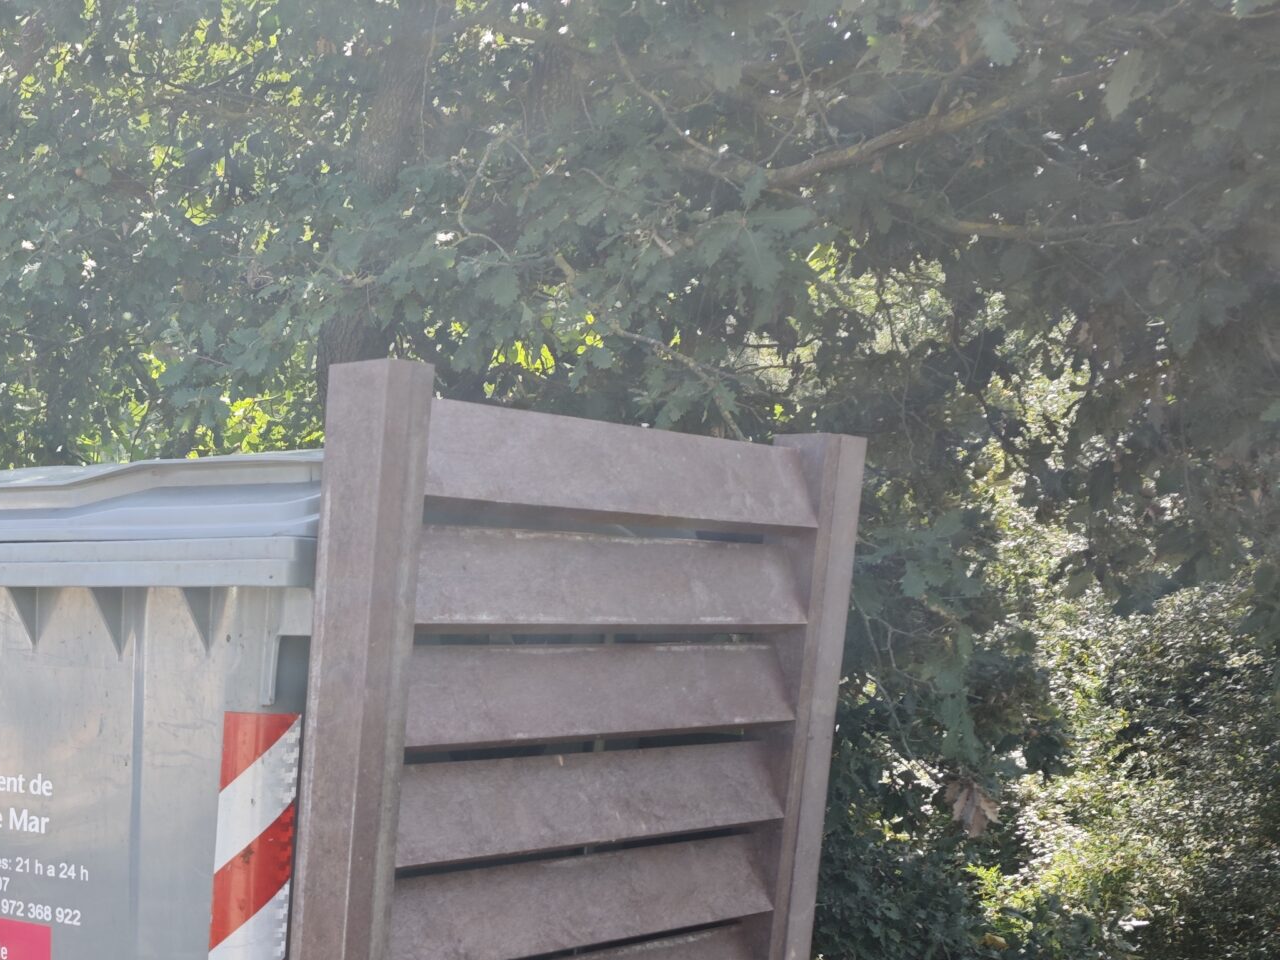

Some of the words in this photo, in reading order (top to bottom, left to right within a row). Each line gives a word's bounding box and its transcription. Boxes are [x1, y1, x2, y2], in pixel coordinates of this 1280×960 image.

[29, 773, 54, 797] de
[9, 807, 50, 834] Mar
[15, 856, 31, 873] 21
[34, 859, 43, 875] h
[46, 865, 56, 877] a
[58, 862, 77, 880] 24
[80, 865, 89, 881] h
[1, 898, 25, 917] 972
[27, 903, 52, 921] 368
[55, 907, 82, 926] 922
